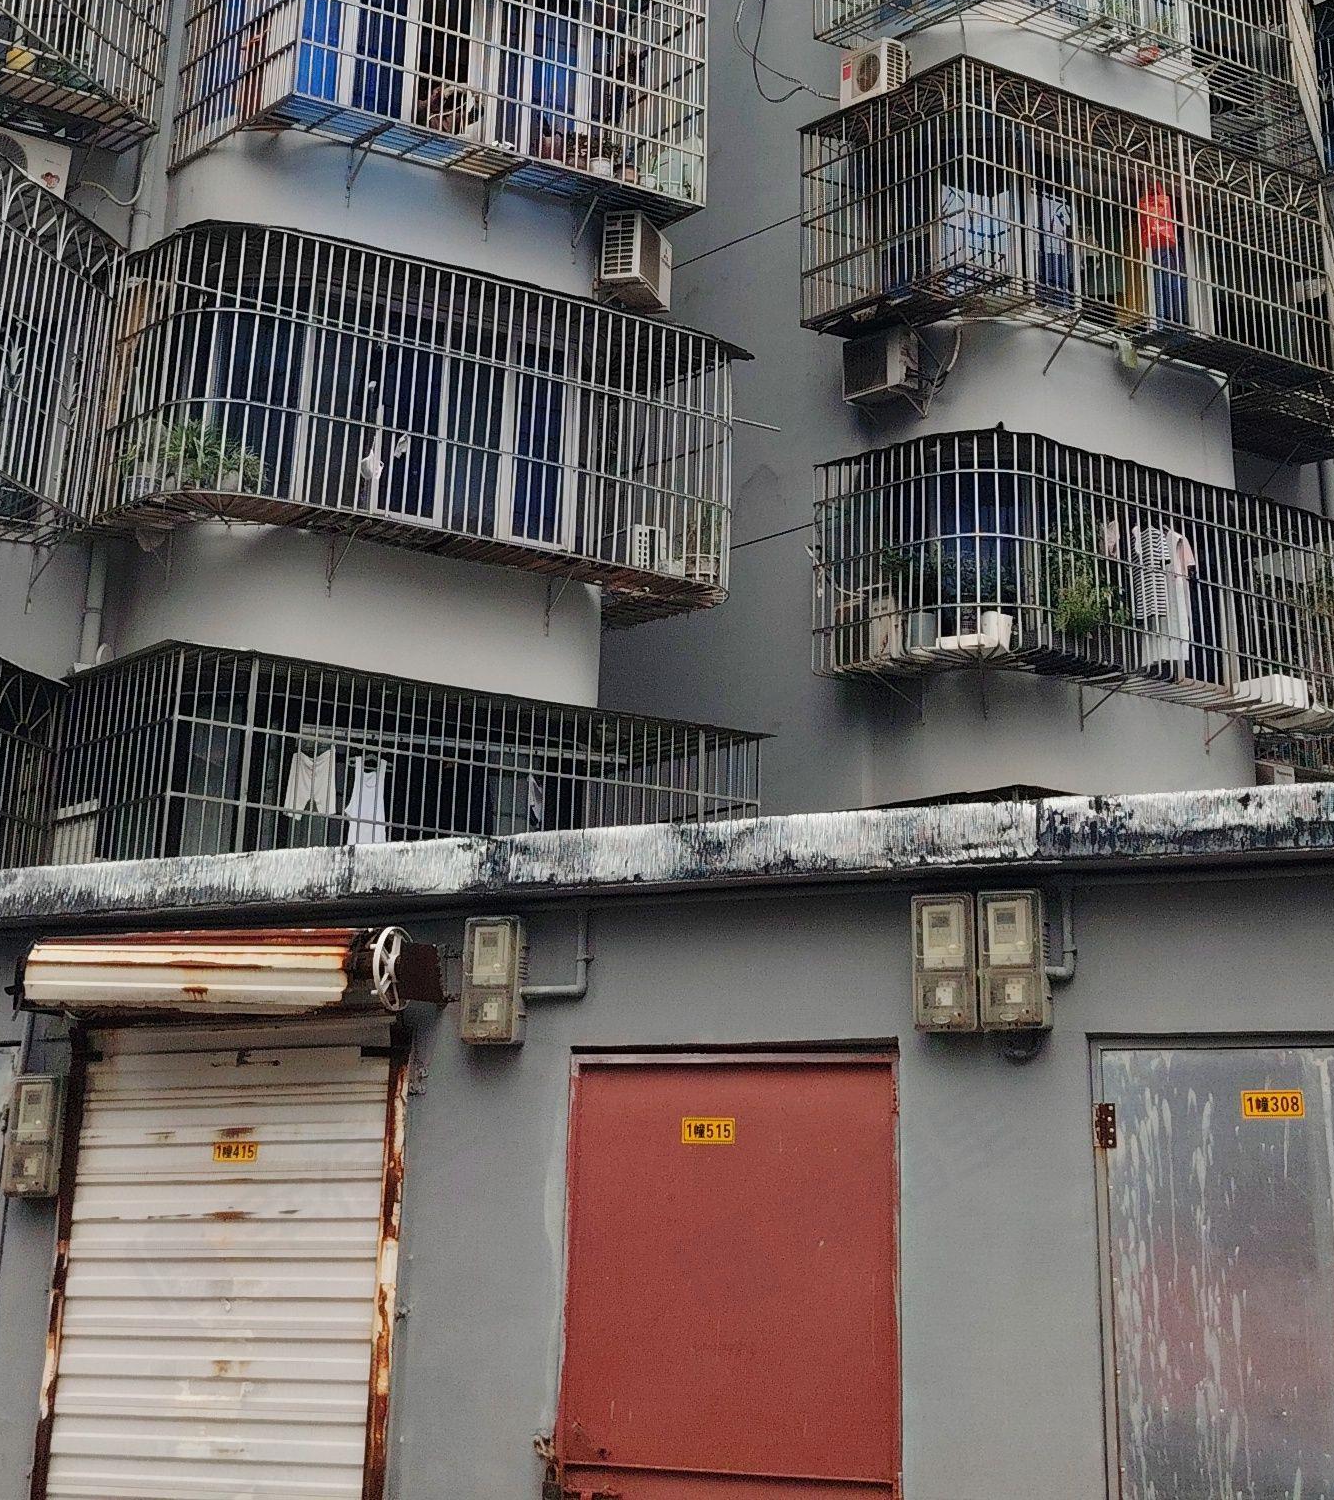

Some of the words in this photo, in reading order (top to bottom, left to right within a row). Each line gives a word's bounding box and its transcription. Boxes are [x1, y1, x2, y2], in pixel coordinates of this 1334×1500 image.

[1247, 1096, 1300, 1113] 1幢308
[686, 1122, 732, 1140] 1幢515
[216, 1143, 255, 1159] 1幢415
